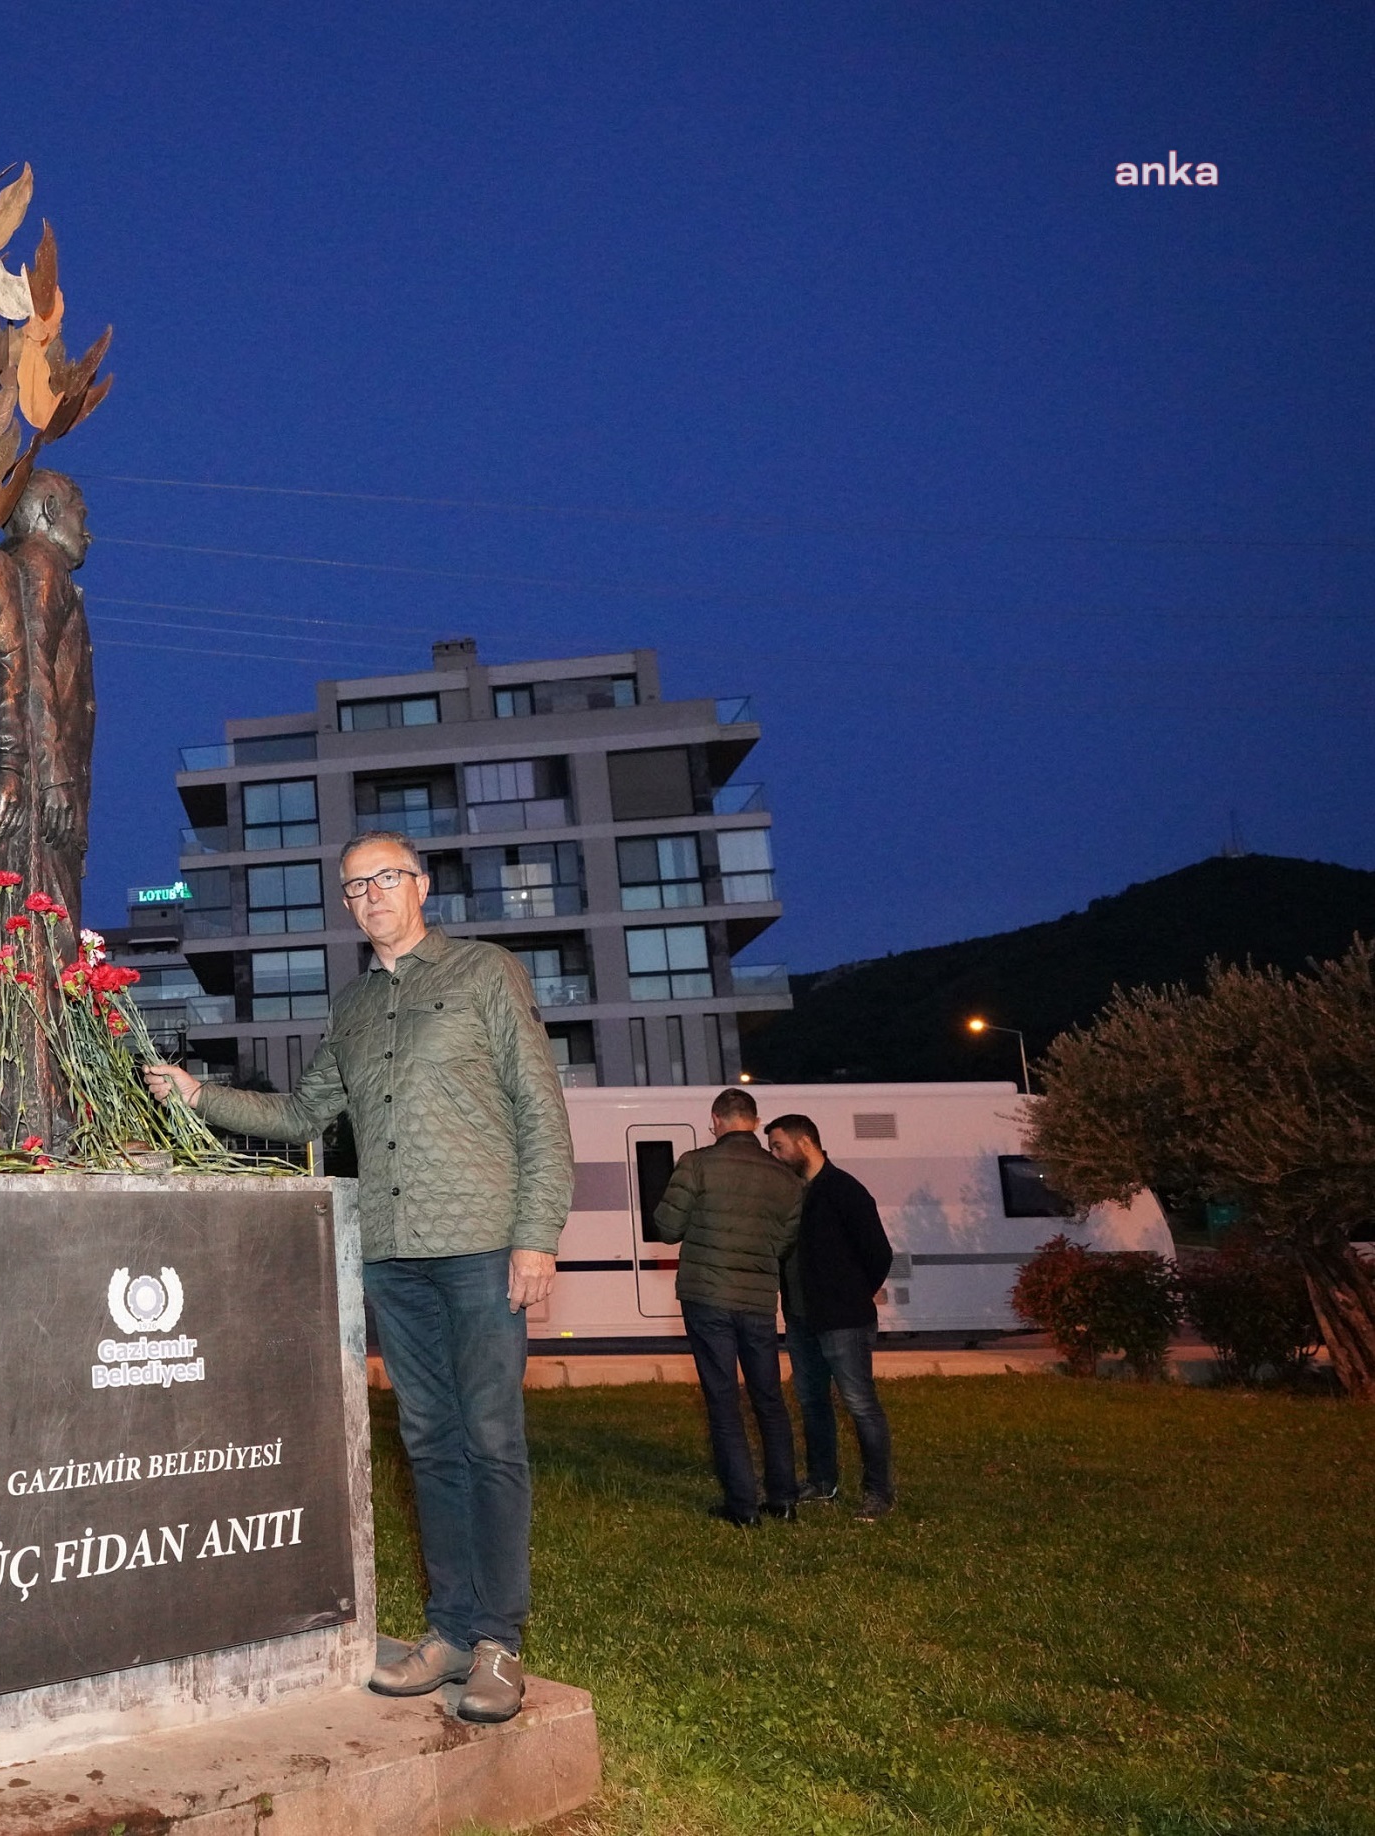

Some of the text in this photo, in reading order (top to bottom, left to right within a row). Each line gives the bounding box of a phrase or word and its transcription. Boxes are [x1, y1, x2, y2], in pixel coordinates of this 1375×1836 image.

[138, 889, 176, 902] LOTUS
[138, 1323, 157, 1331] 1926
[97, 1335, 198, 1363] Gaziemir
[91, 1358, 205, 1390] Belediyesi
[7, 1437, 283, 1497] GAZİEMİR BELEDİYESİ
[50, 1523, 189, 1585] FİDAN
[196, 1507, 305, 1560] ANITI
